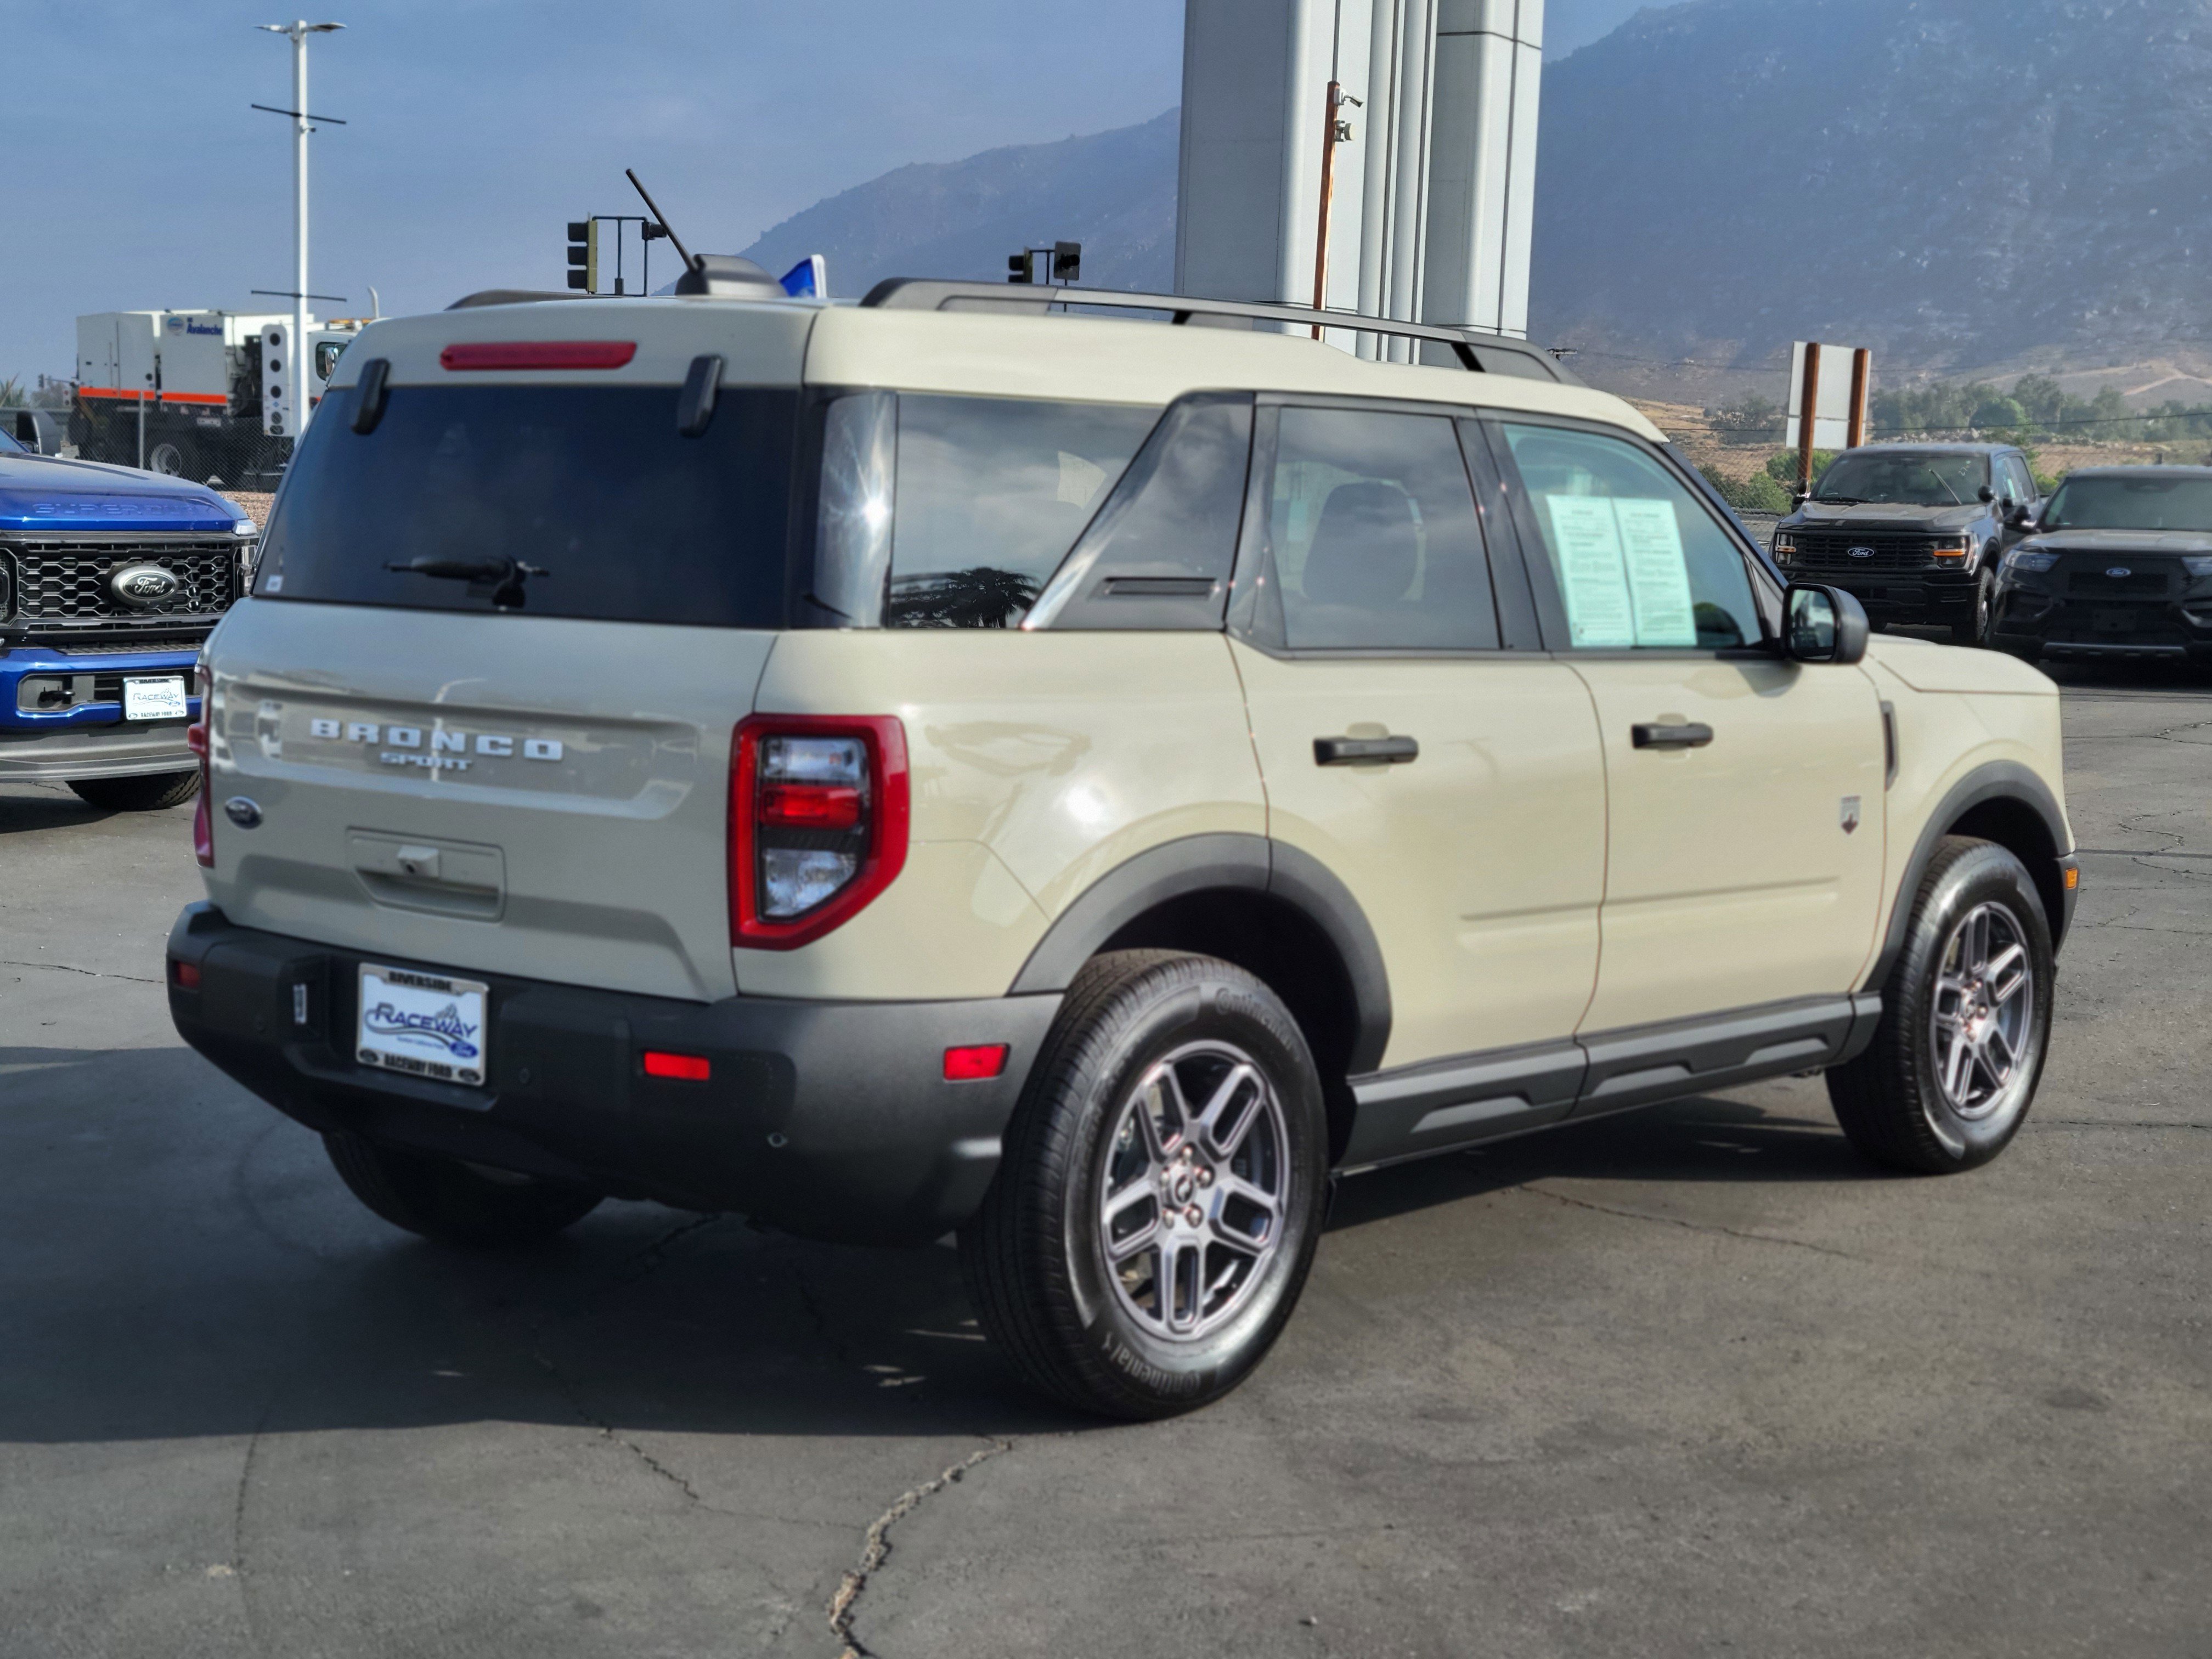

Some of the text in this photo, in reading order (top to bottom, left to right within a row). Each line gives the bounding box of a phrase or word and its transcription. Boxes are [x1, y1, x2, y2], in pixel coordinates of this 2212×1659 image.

[187, 324, 223, 335] Avalanche
[33, 504, 142, 515] SUPER
[134, 577, 165, 594] Ford
[311, 718, 563, 760] BRONCO
[381, 752, 472, 770] SPORT
[389, 971, 452, 991] RIVERSIDE
[385, 1054, 426, 1072] RACEWAY
